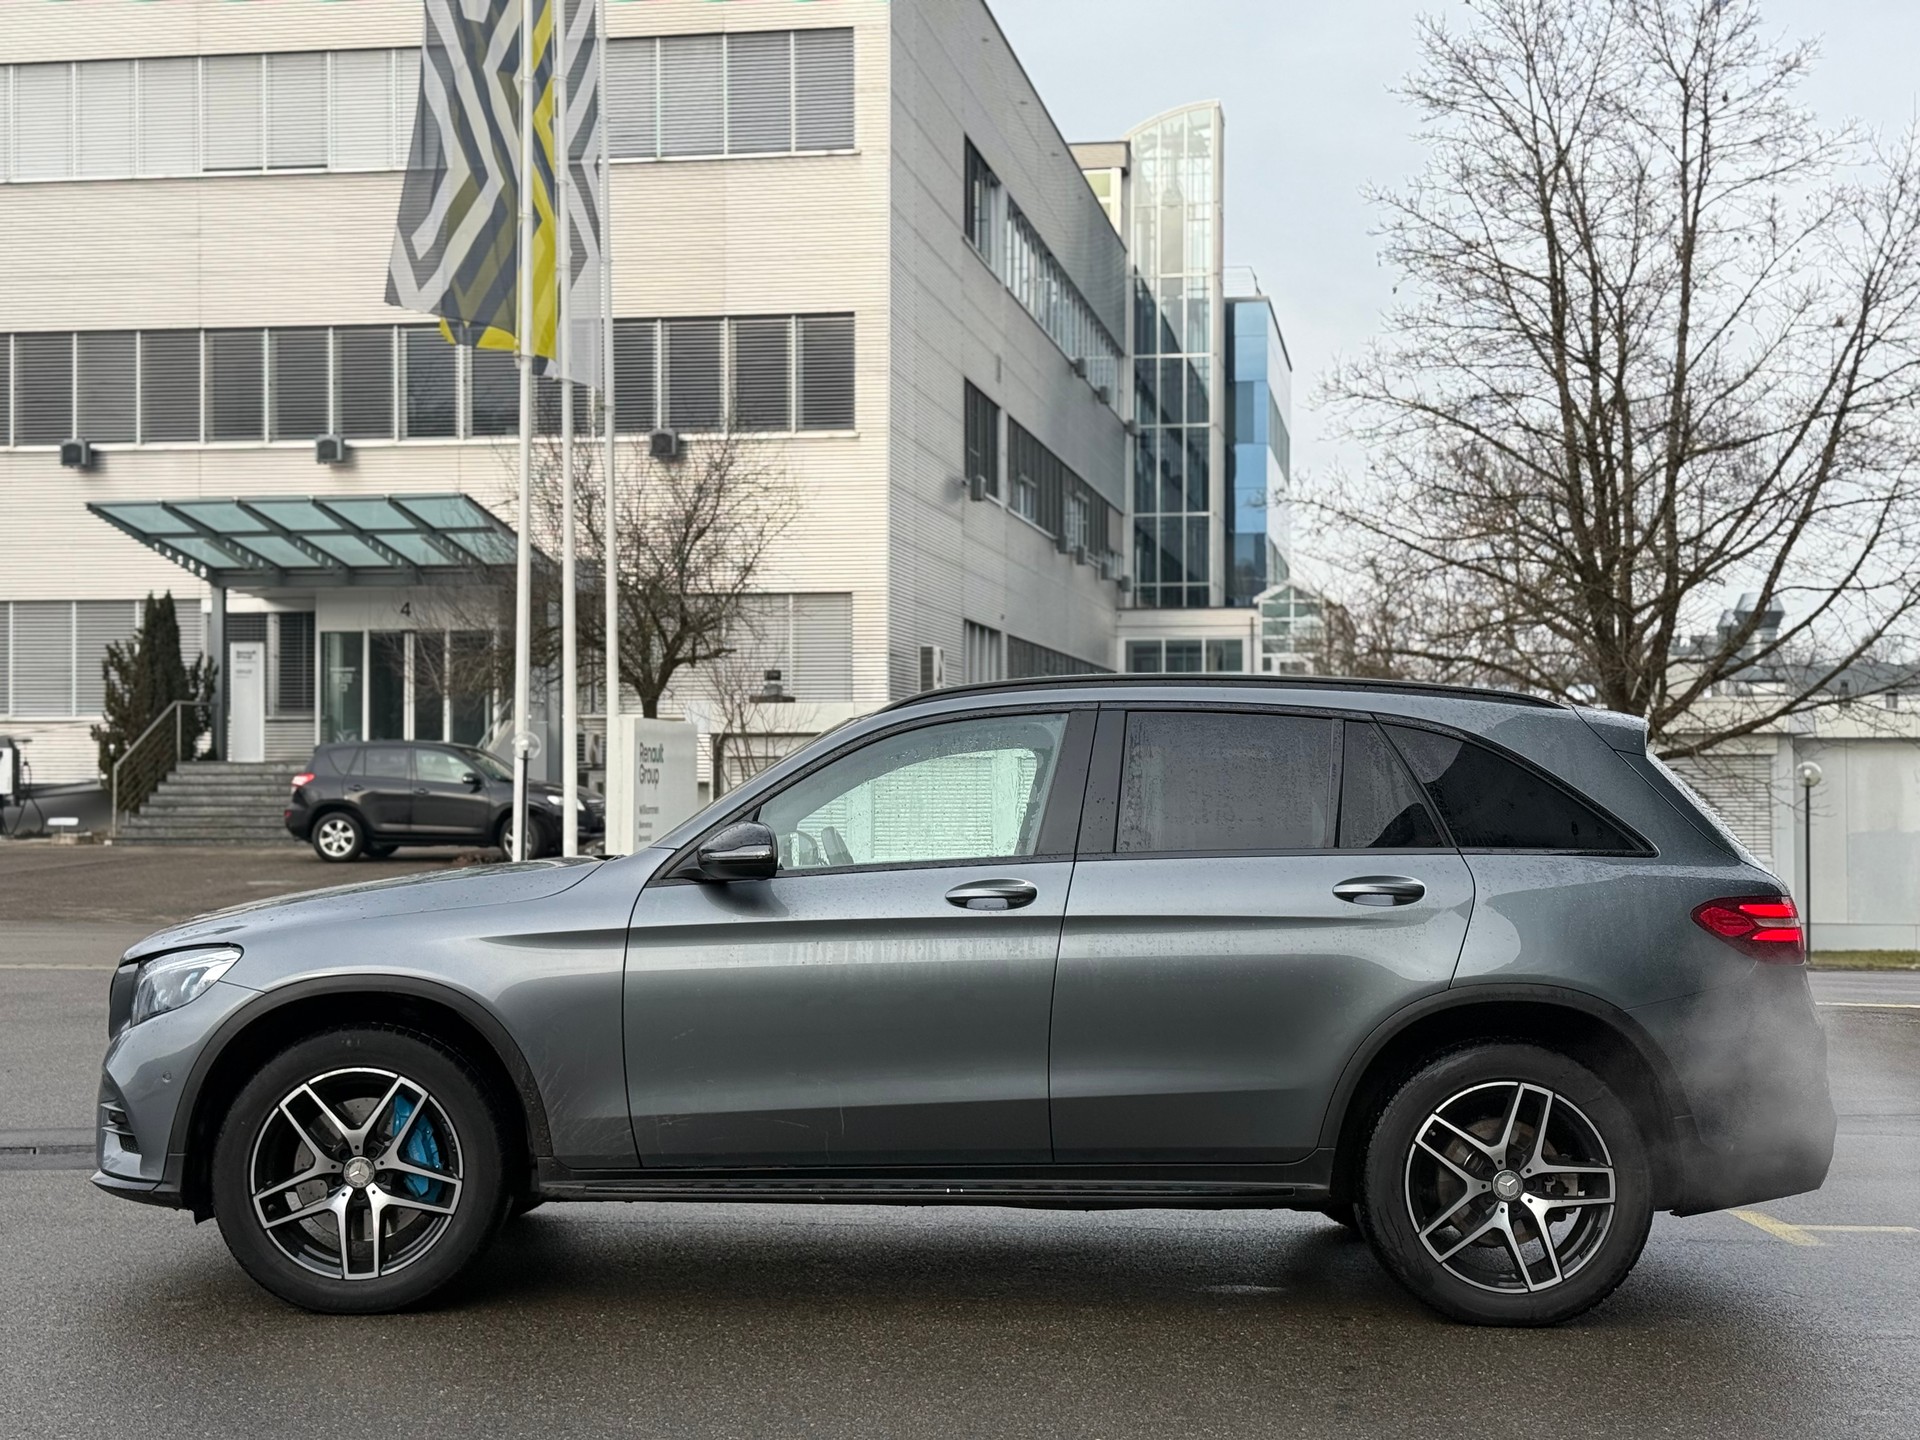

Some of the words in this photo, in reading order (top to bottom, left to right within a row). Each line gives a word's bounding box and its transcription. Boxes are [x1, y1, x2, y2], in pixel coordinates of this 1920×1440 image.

[400, 601, 411, 617] 4
[639, 742, 664, 763] Renault
[639, 763, 660, 790] Group
